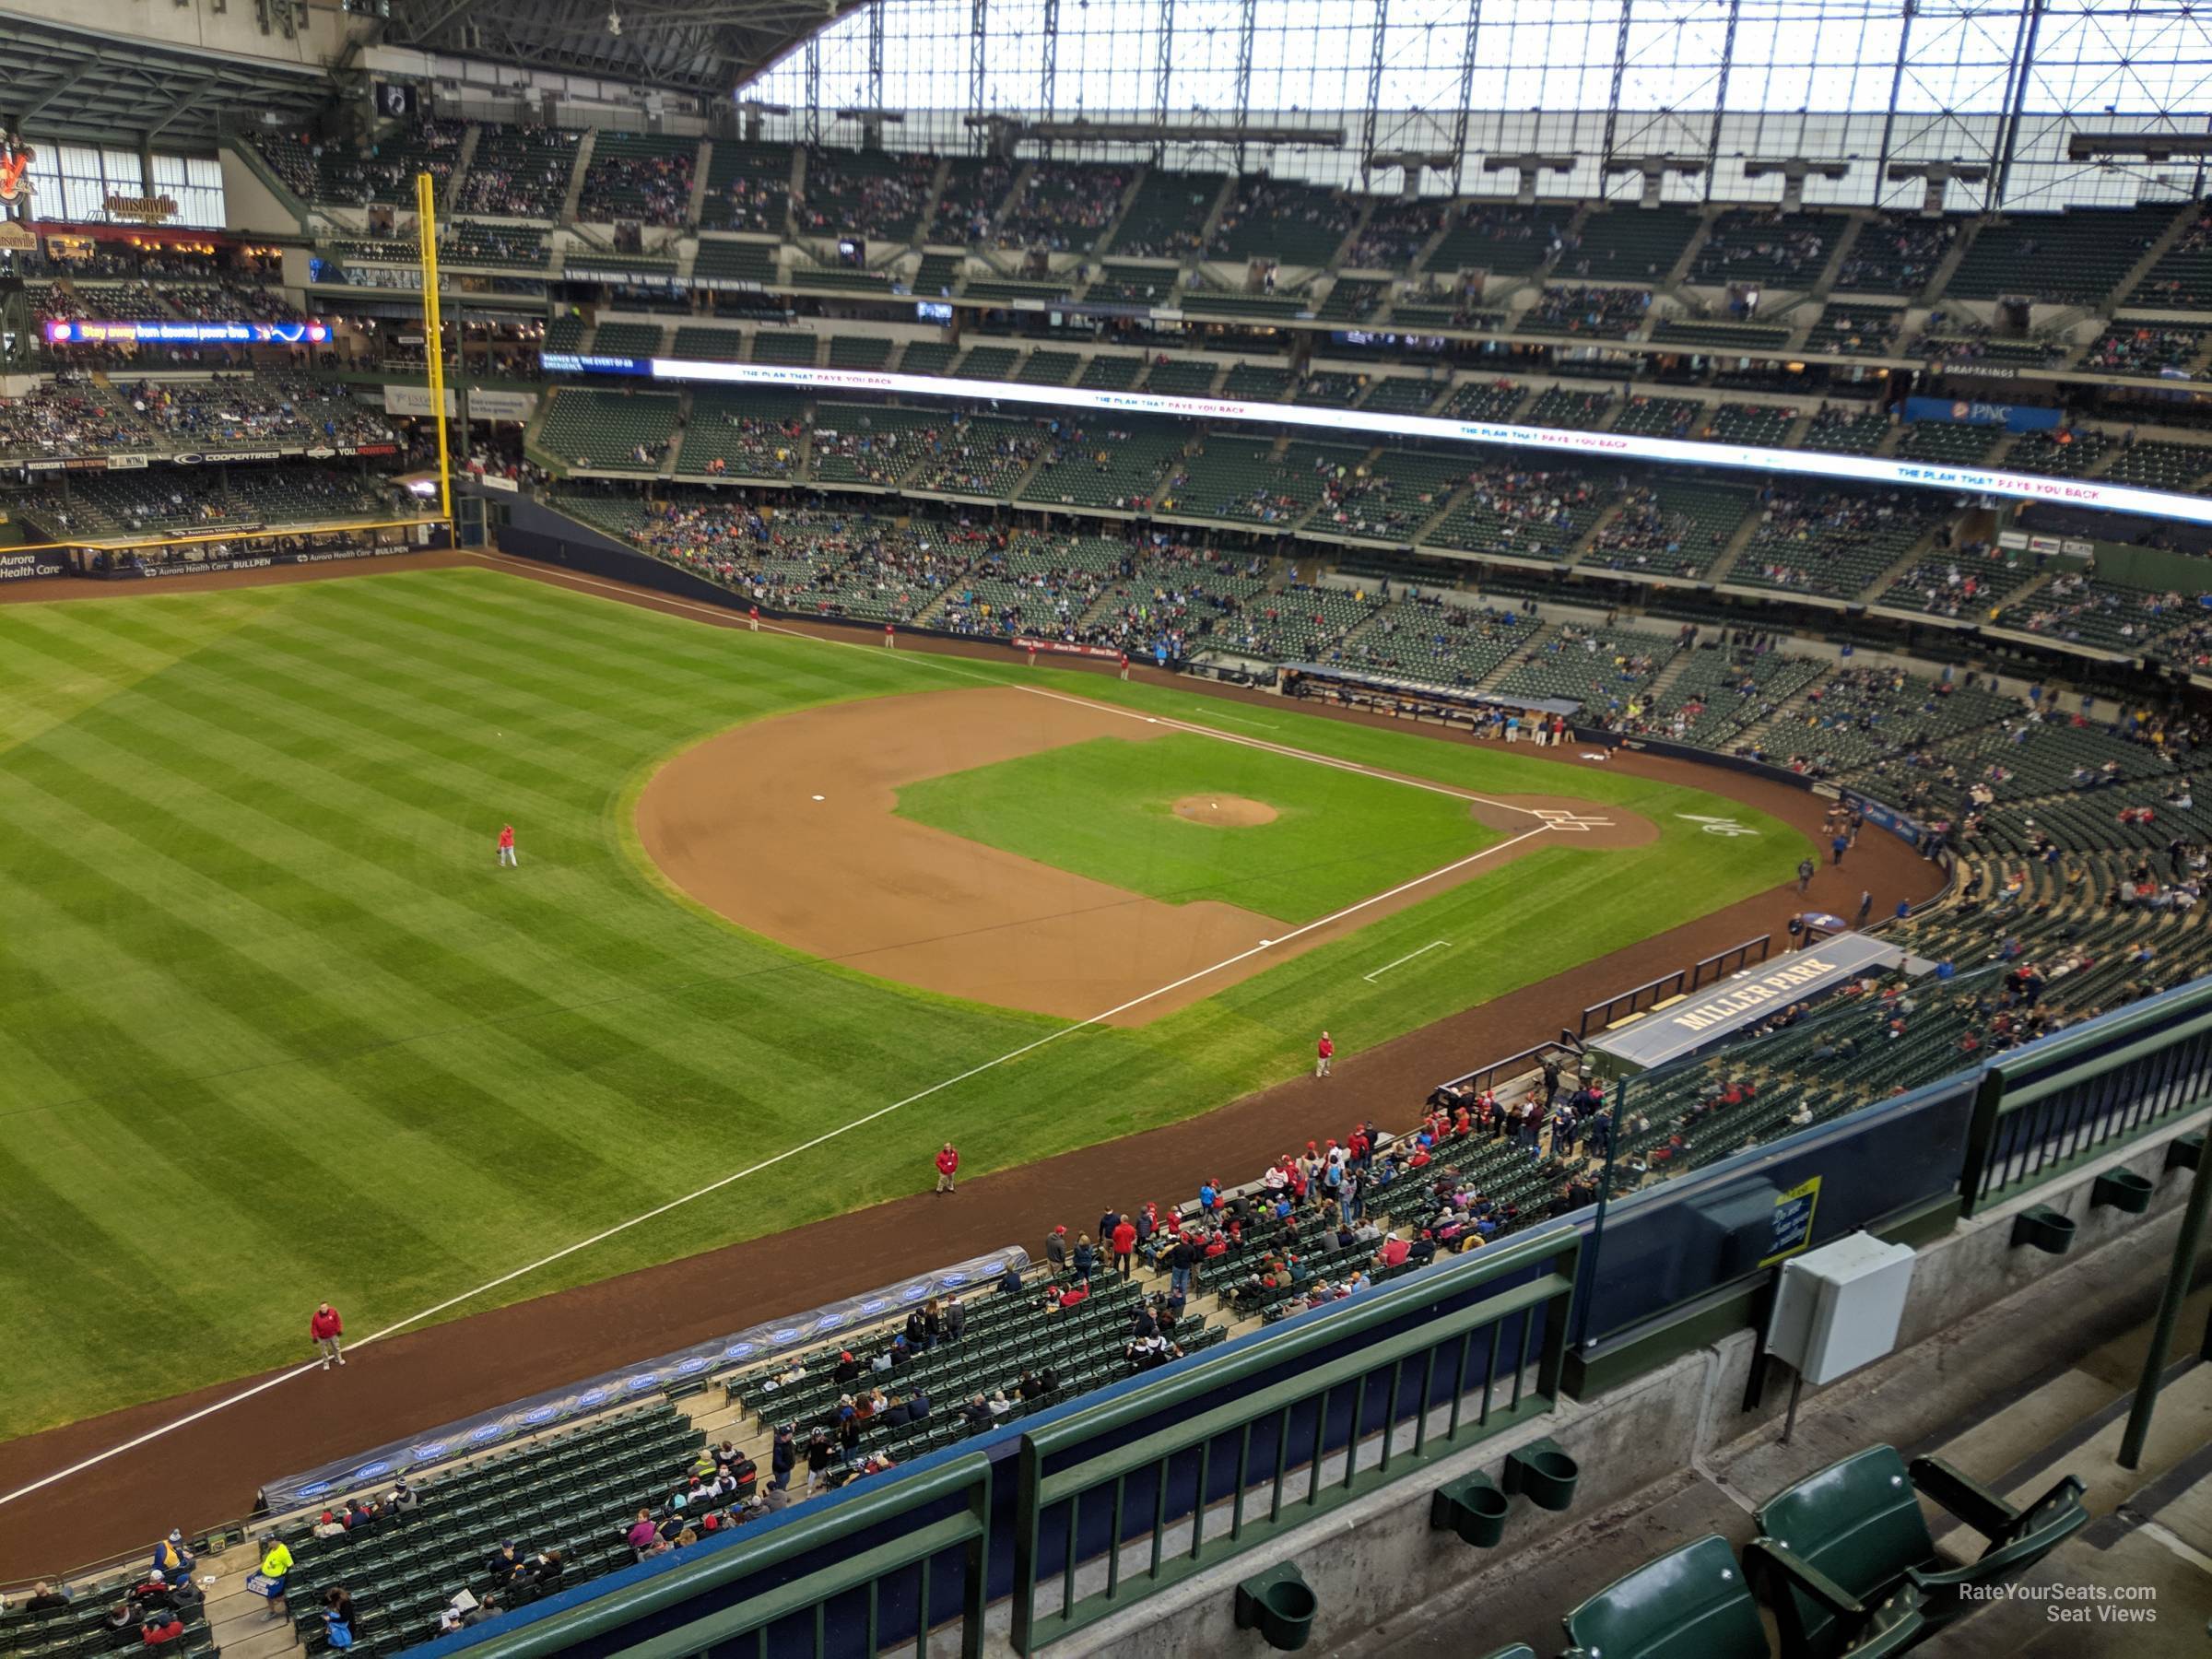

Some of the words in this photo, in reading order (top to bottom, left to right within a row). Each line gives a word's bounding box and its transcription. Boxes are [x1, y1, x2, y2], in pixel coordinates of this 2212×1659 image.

[82, 325, 106, 339] Stay
[1971, 404, 2013, 422] PNC
[0, 555, 35, 565] Aurora
[310, 553, 333, 561] Aurora
[334, 551, 355, 559] Health
[0, 566, 34, 579] Health
[37, 564, 60, 575] Care
[159, 566, 184, 576] Aurora
[185, 563, 210, 573] Health
[212, 561, 229, 571] Care
[233, 559, 271, 569] BULLPEN
[1673, 983, 1781, 1031] MILLER
[1762, 958, 1837, 990] PARK
[582, 1392, 604, 1403] Carrier
[529, 1408, 553, 1420] Carrier
[418, 1444, 443, 1457] Carrier
[360, 1464, 385, 1477] Carrier
[300, 1483, 326, 1496] Carrier
